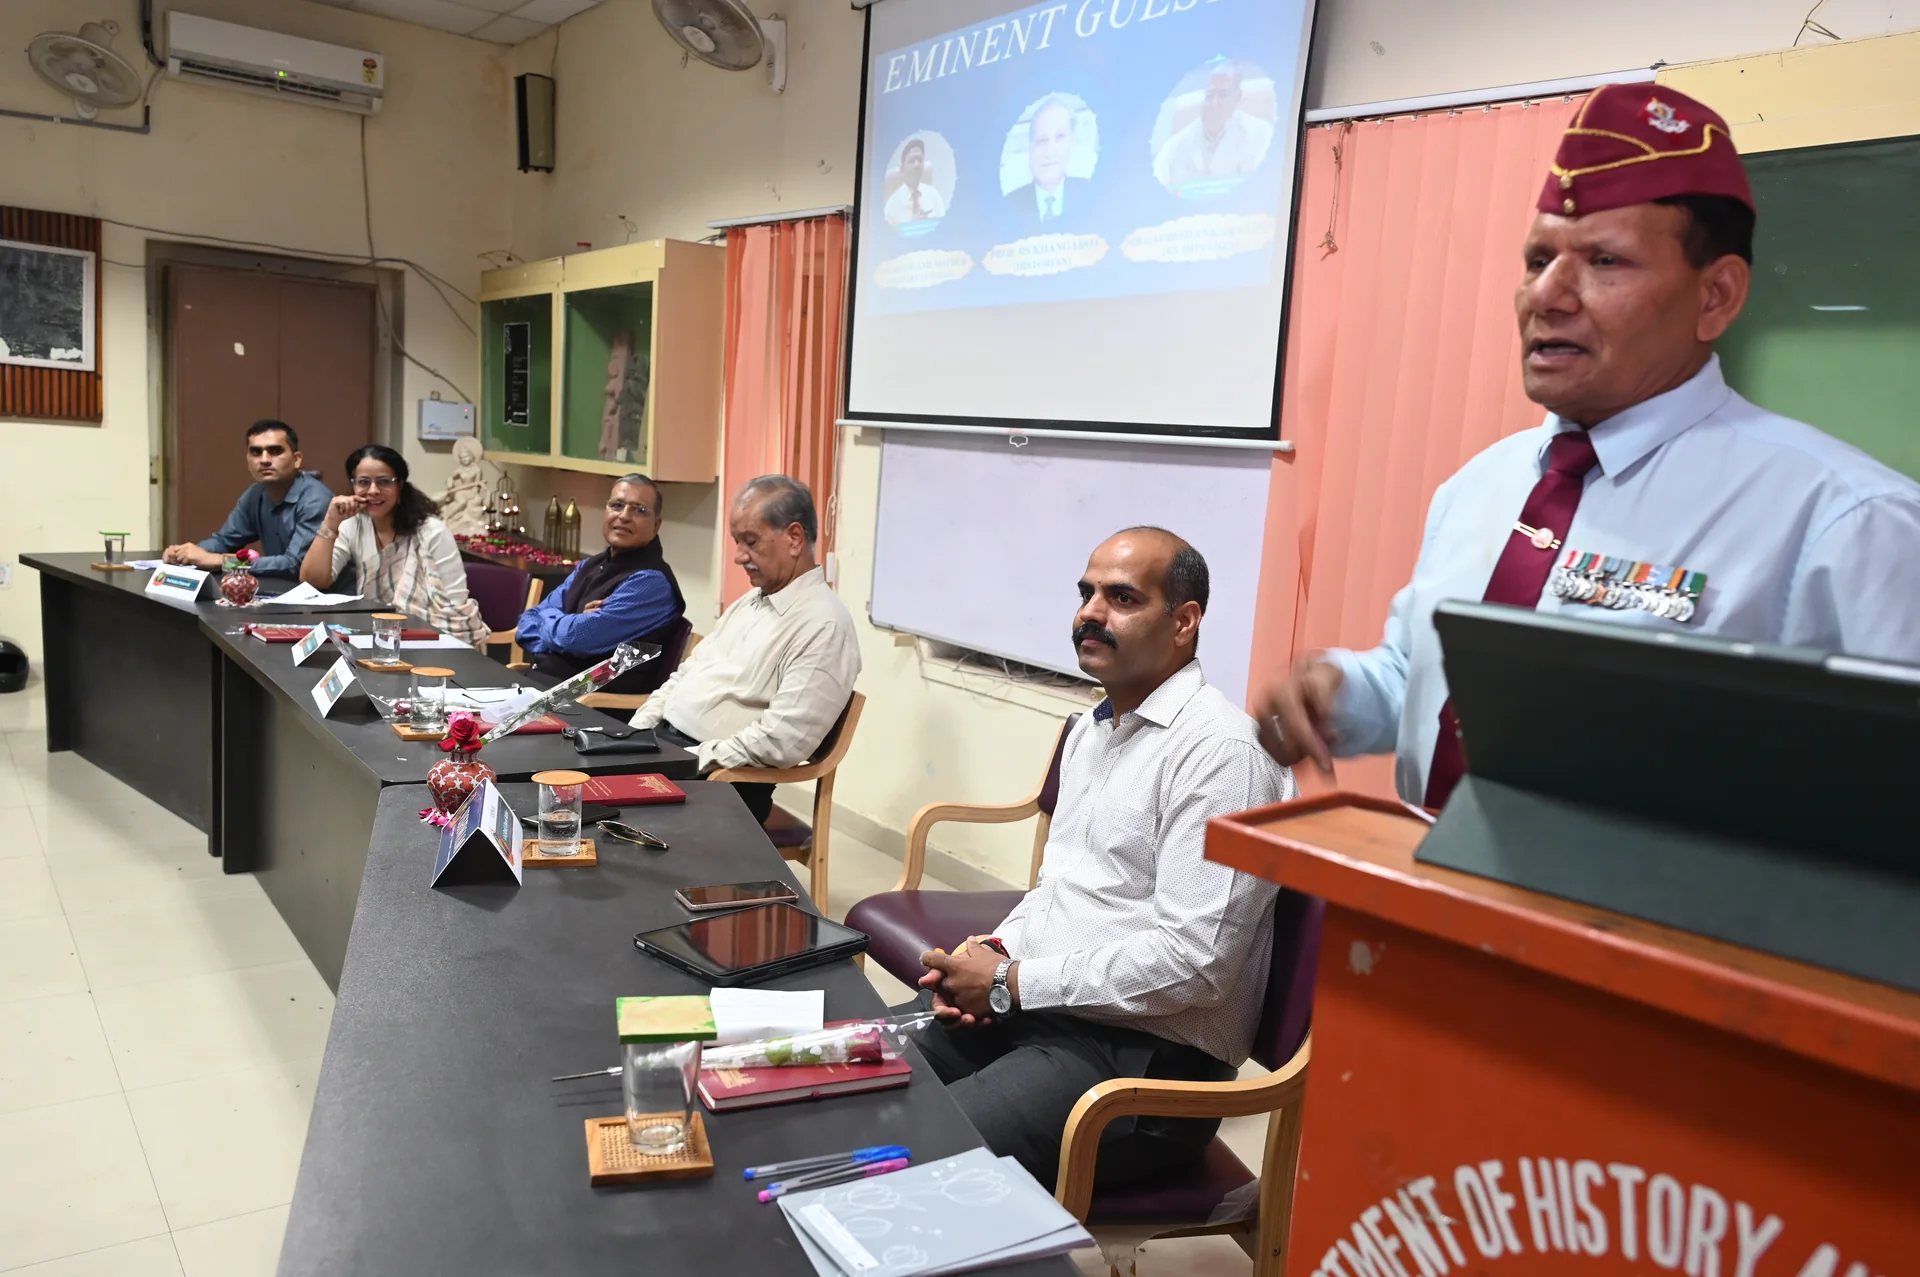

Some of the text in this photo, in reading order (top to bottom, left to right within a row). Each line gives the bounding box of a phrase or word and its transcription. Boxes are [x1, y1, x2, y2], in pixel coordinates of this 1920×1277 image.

[882, 3, 1067, 94] EMINENT
[1310, 1156, 1785, 1277] TMENT OF HISTORY
